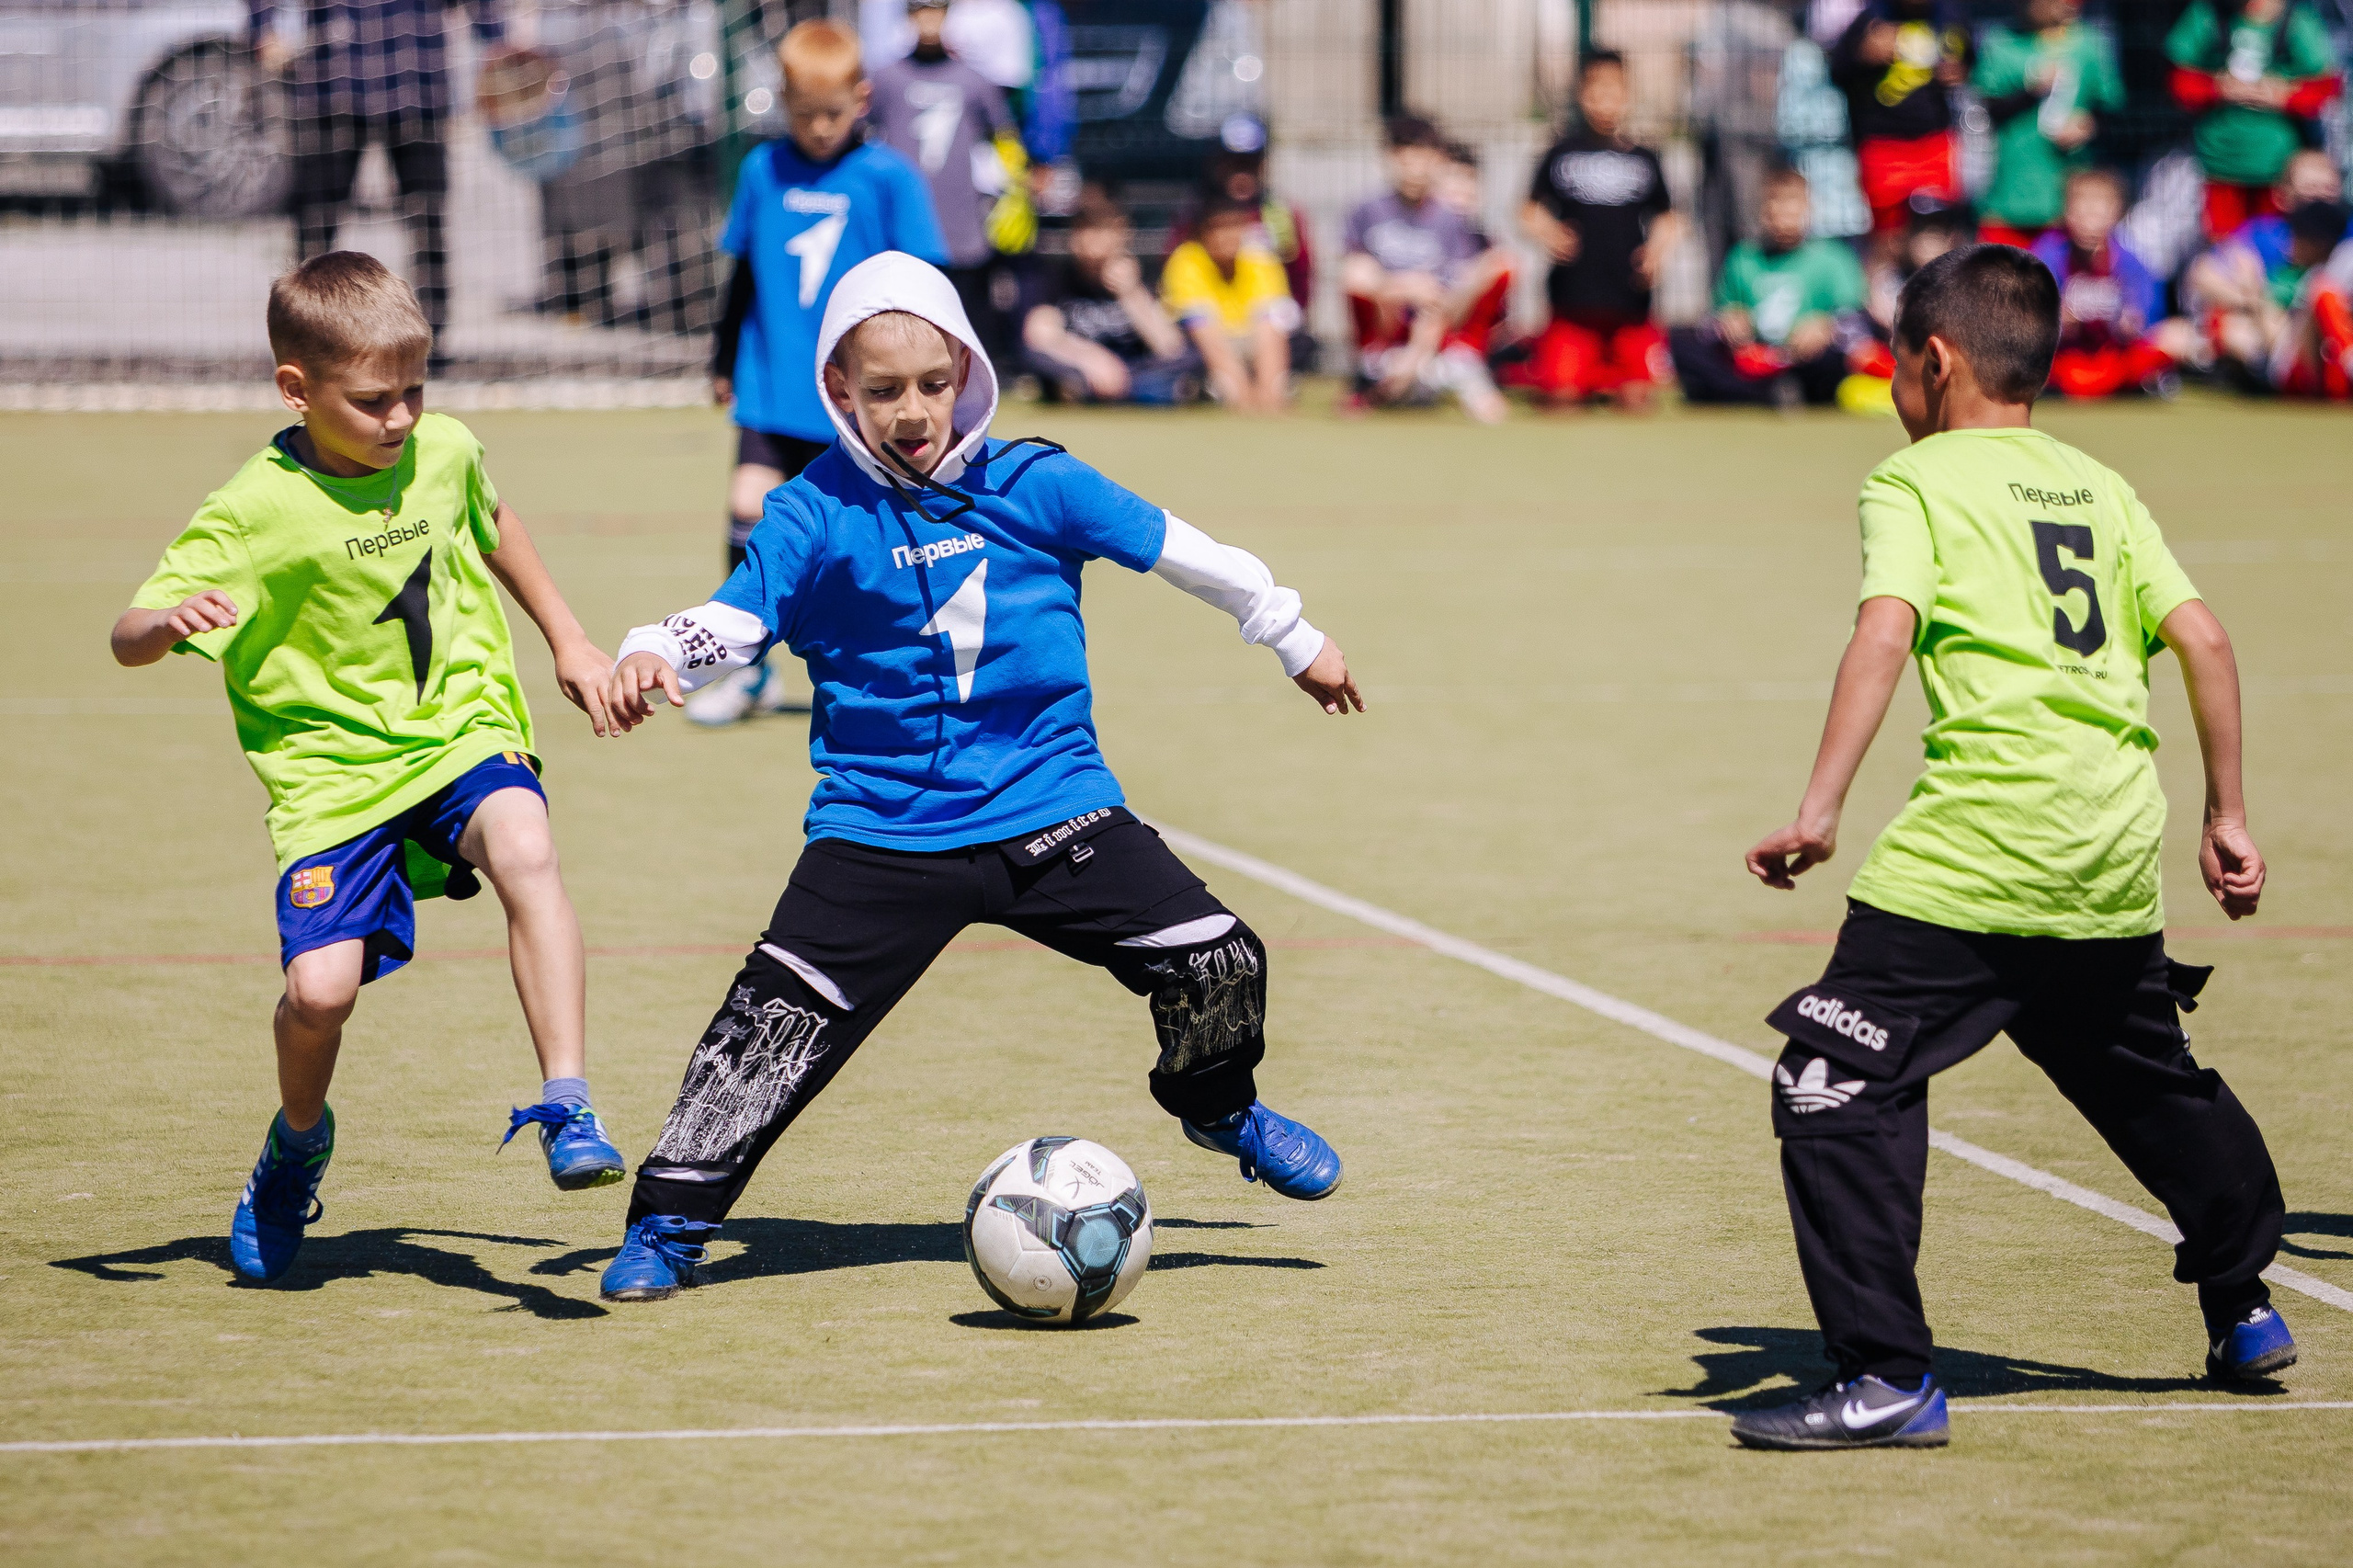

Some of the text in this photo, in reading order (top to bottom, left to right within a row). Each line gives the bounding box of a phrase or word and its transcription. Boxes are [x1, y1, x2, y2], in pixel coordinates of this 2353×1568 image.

[2007, 483, 2095, 510] Первые
[344, 518, 431, 561] Первые
[891, 532, 986, 570] Первые
[2028, 519, 2107, 658] 5
[1024, 807, 1112, 858] Limited
[1797, 994, 1890, 1051] adidas
[1068, 1159, 1106, 1188] JÖGEL
[1085, 1160, 1103, 1176] TEAM
[1805, 1413, 1825, 1425] CR7
